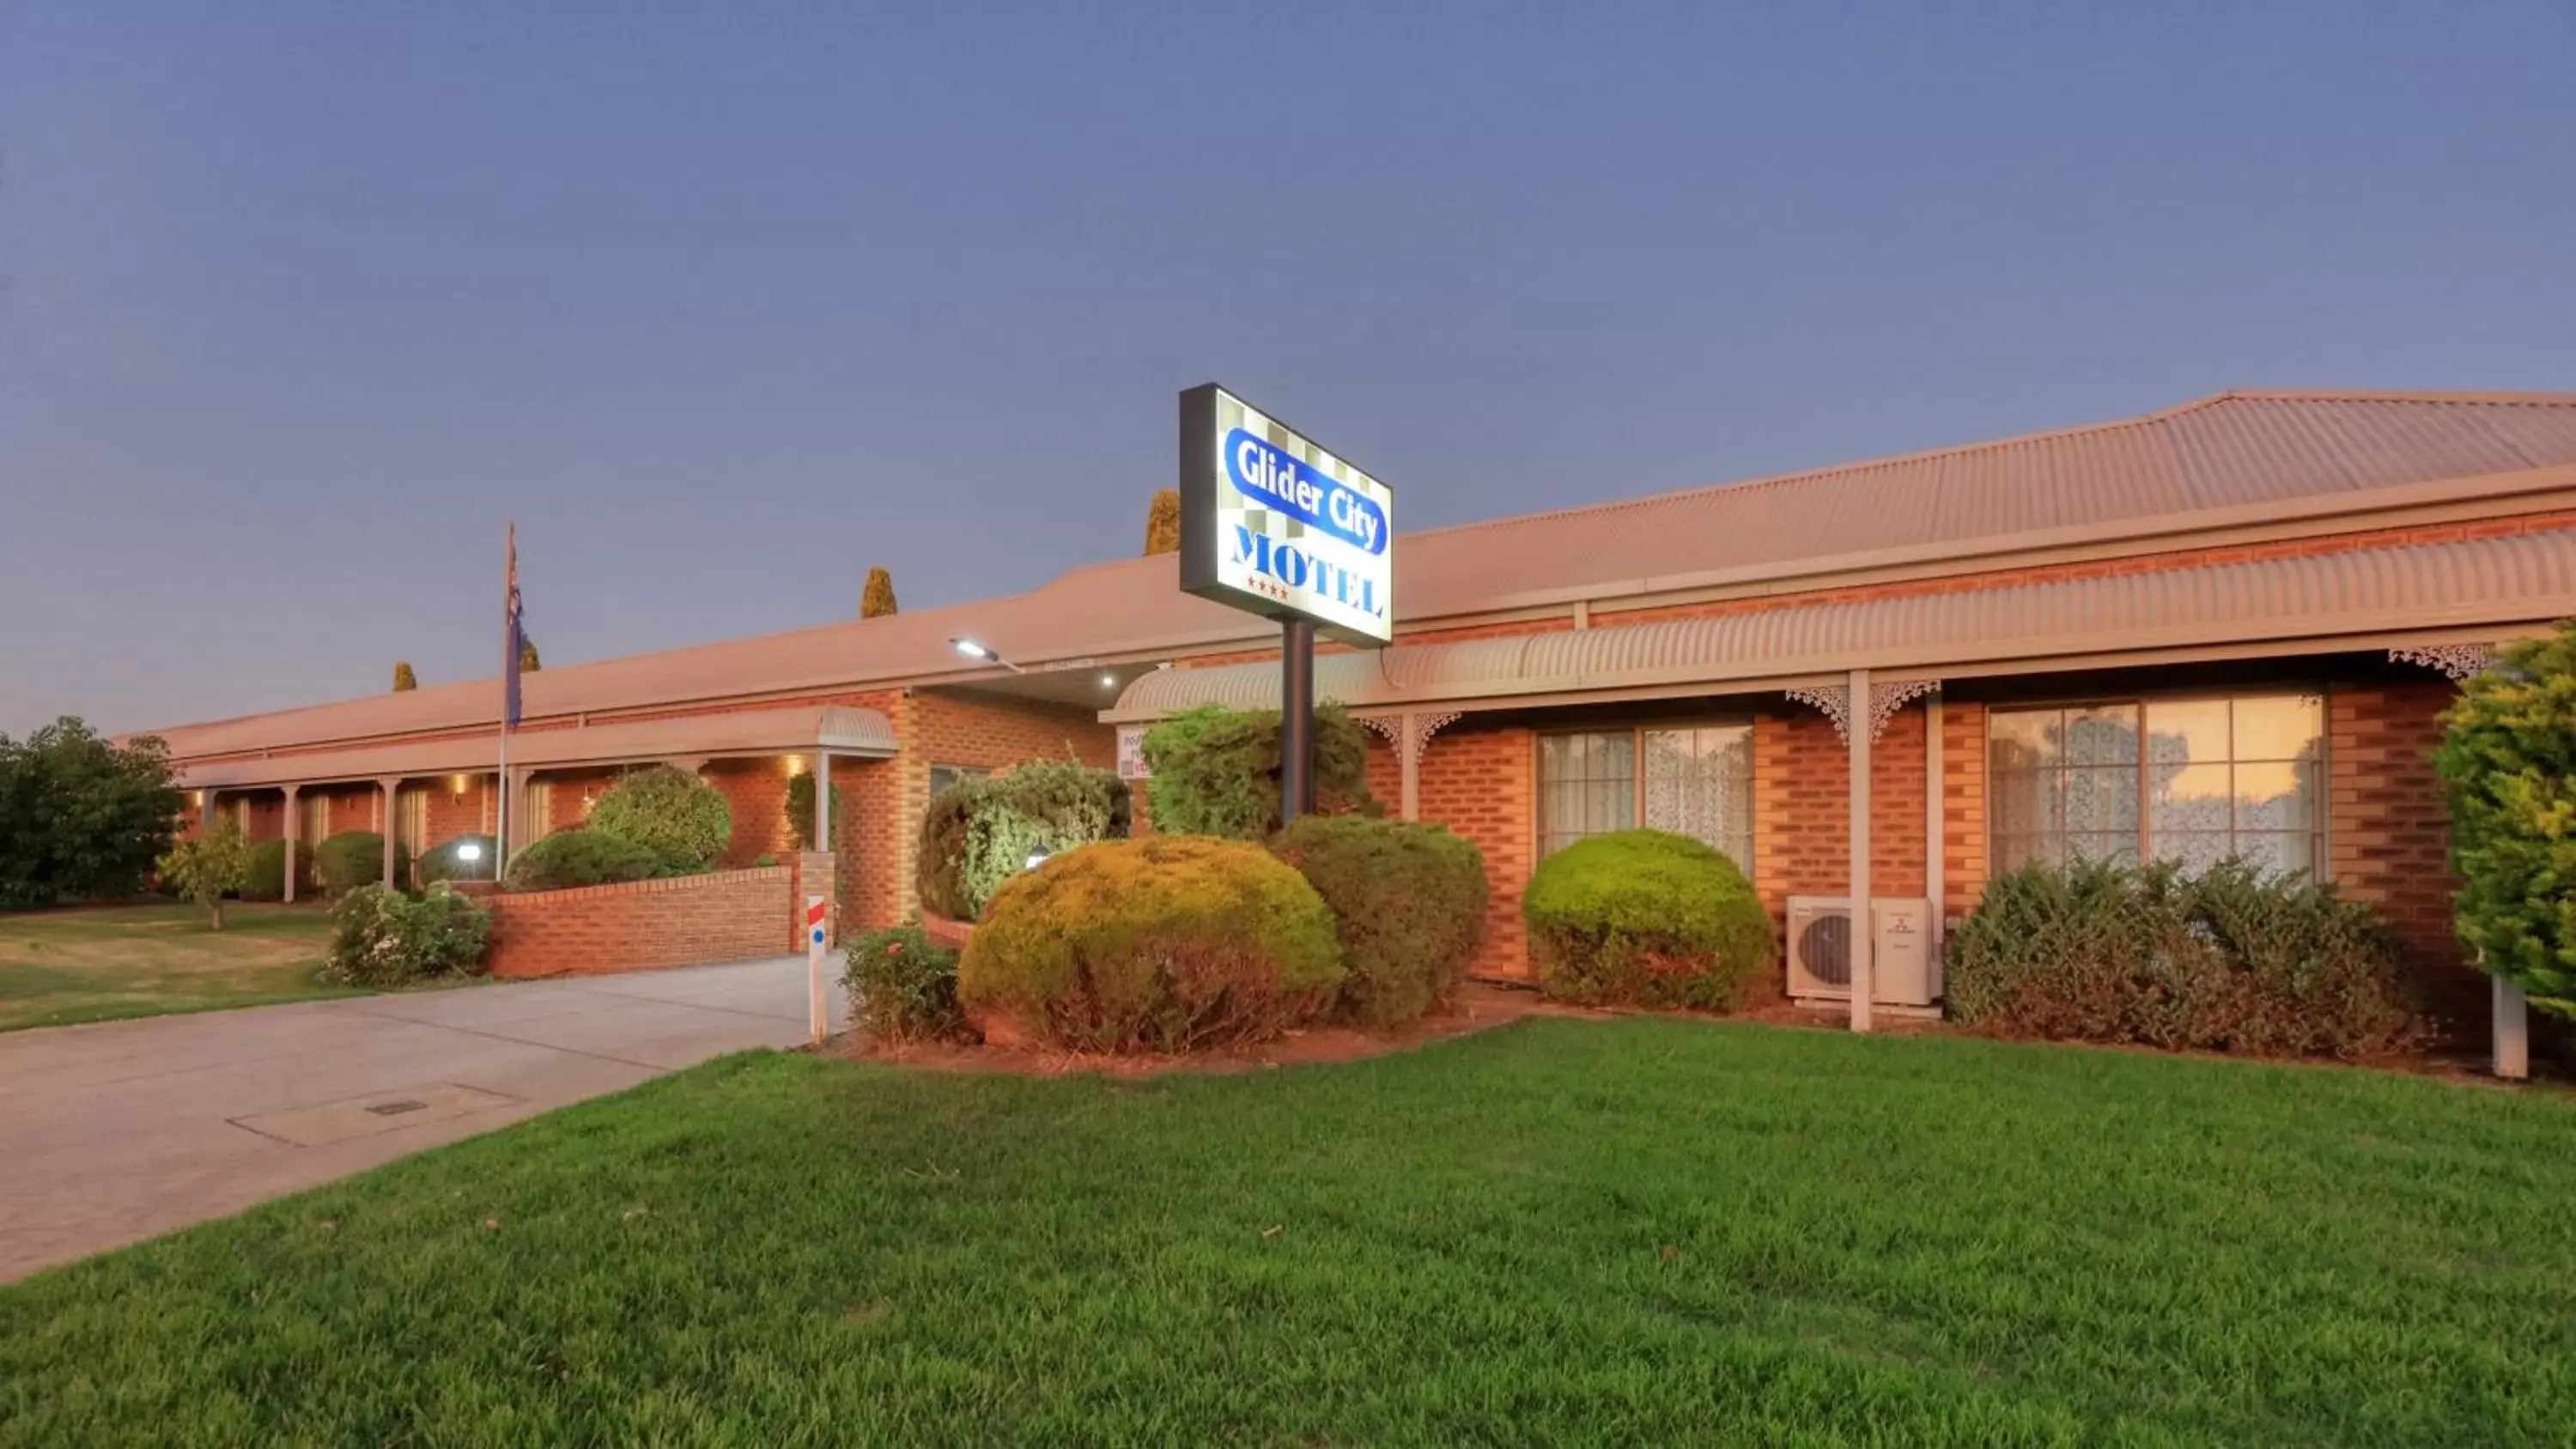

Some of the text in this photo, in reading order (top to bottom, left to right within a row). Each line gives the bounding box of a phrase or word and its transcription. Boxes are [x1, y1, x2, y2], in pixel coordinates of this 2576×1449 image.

[1237, 440, 1378, 550] Glider City
[1231, 524, 1383, 619] MOTEL
